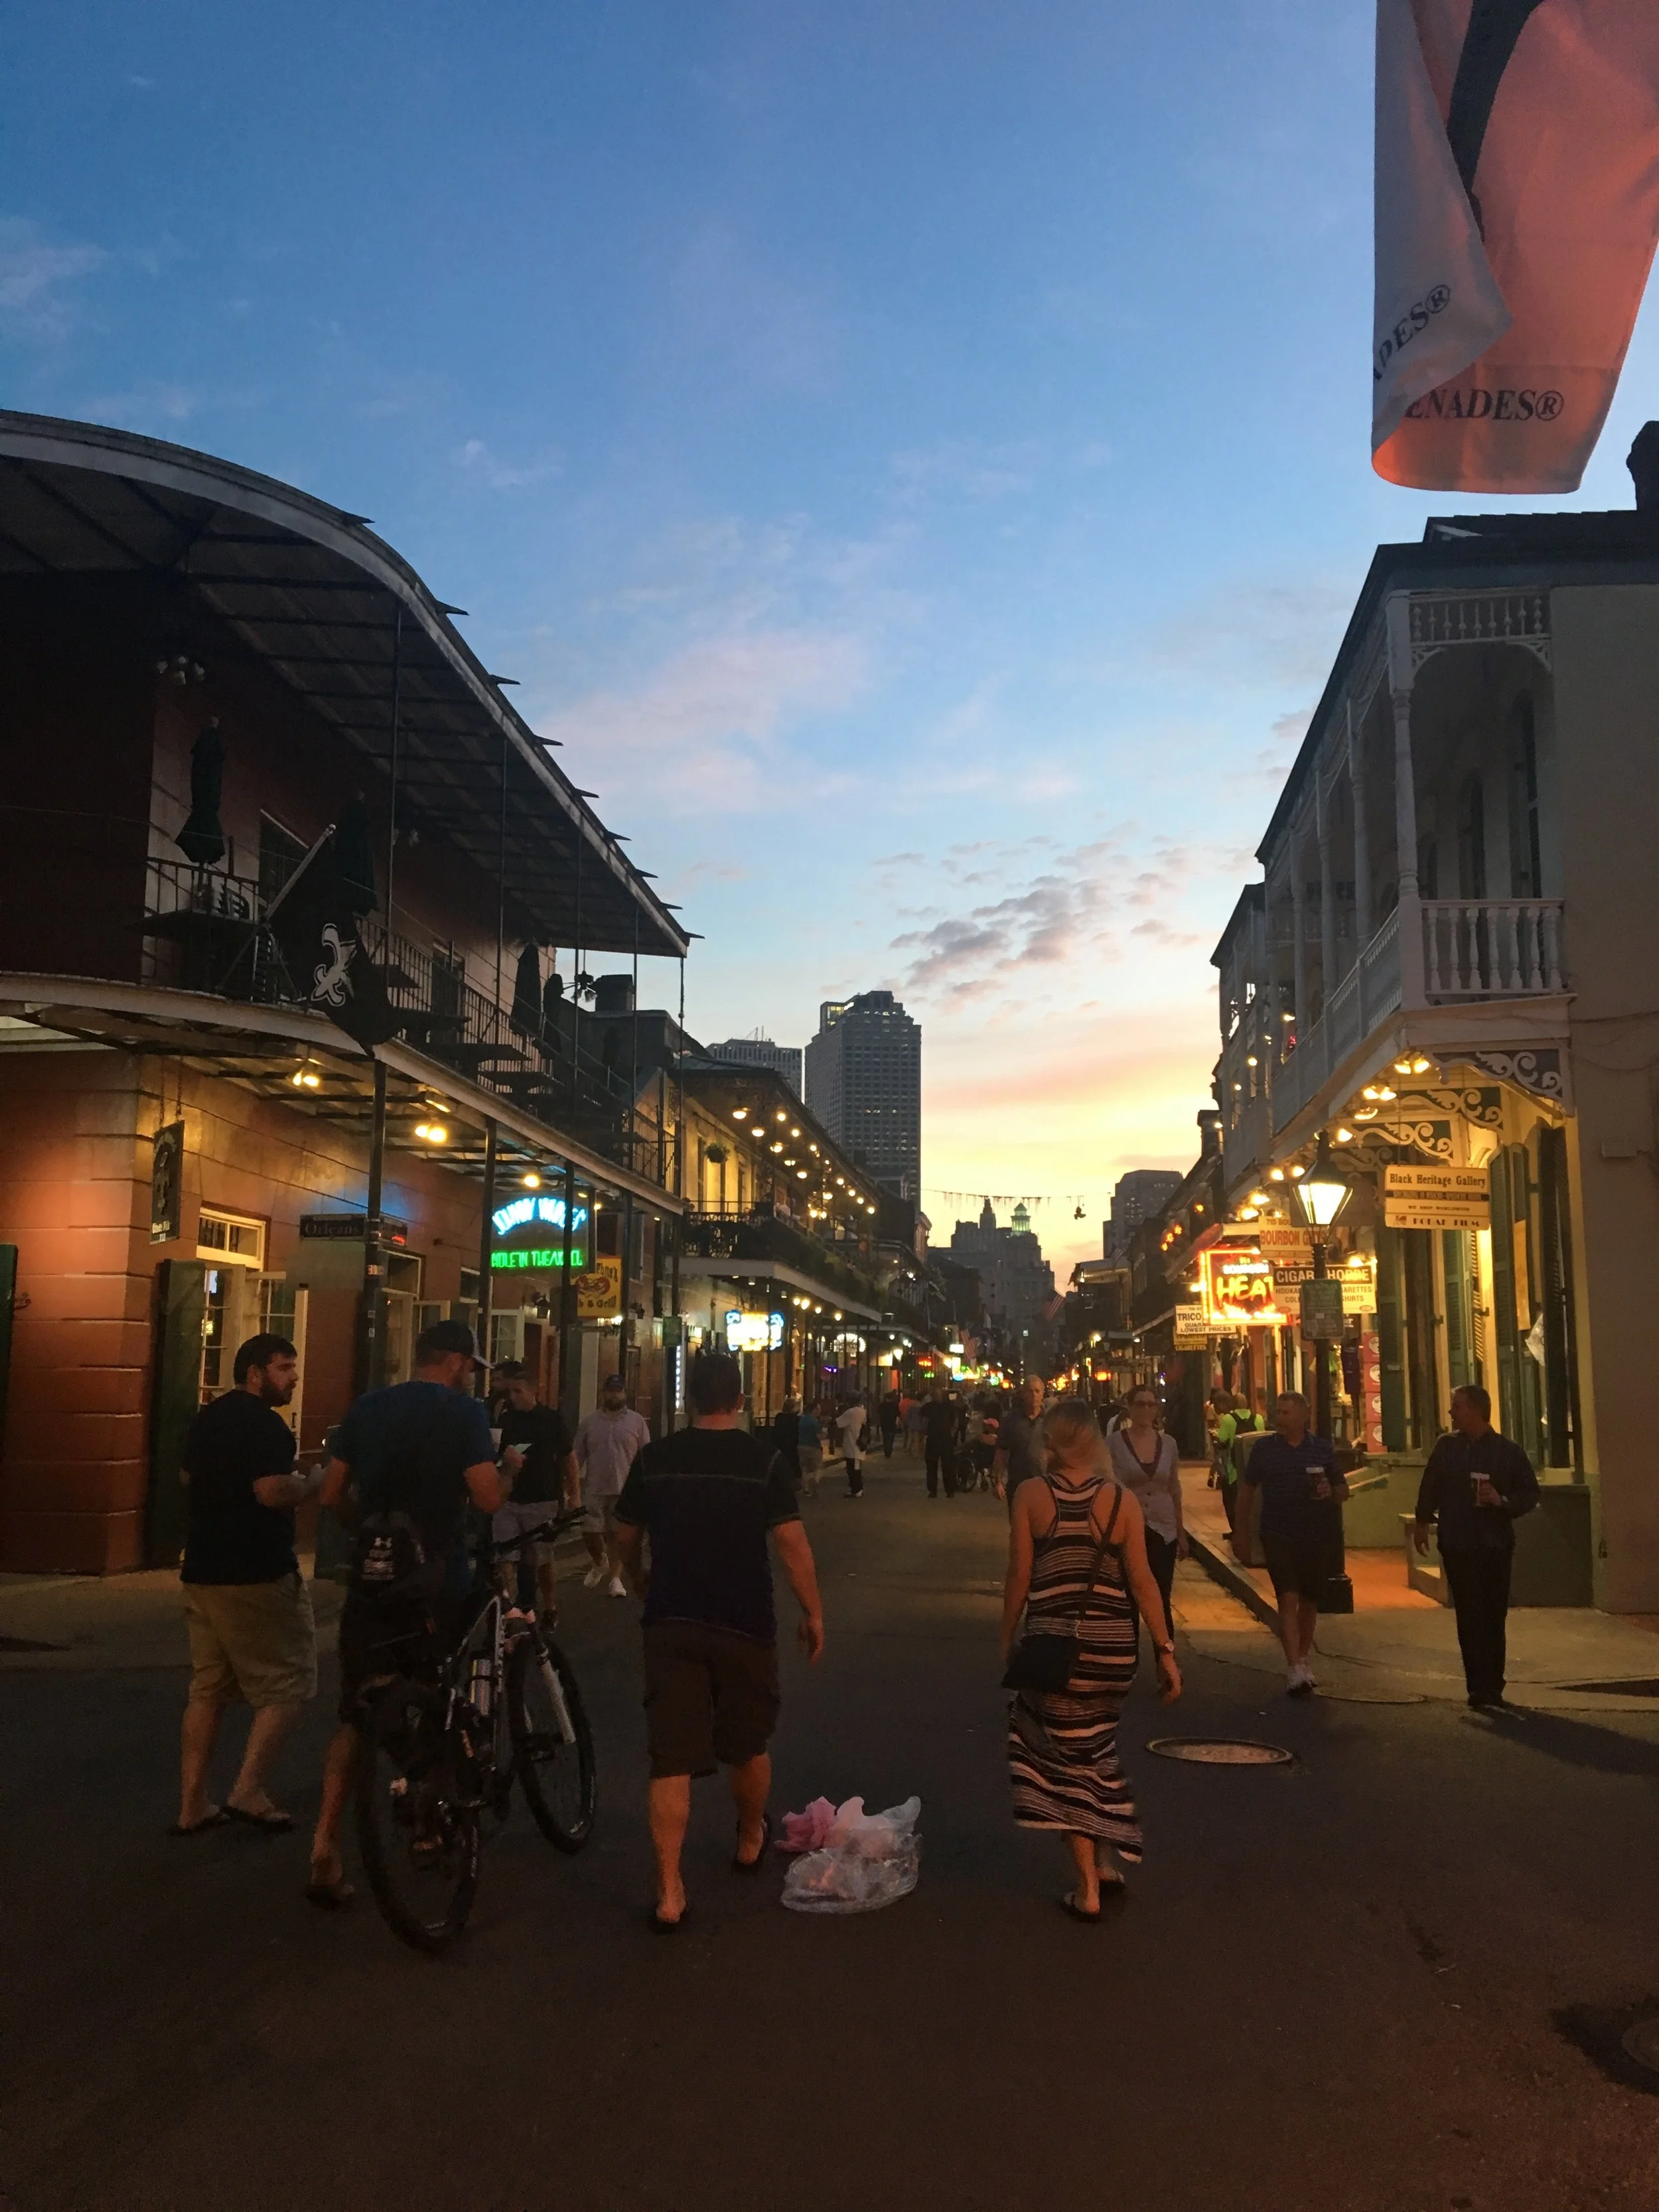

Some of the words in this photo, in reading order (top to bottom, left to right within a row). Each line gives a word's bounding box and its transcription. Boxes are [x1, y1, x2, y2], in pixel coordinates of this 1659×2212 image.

[1390, 1173, 1412, 1183] Black
[1417, 1174, 1451, 1187] Heritage
[1456, 1175, 1486, 1189] Gallery
[305, 1222, 360, 1236] Orleans
[1260, 1230, 1300, 1245] BOURBON
[1276, 1269, 1315, 1283] CIGAR
[1327, 1269, 1370, 1282] HOPPE
[1216, 1276, 1273, 1307] HEAT
[597, 1295, 617, 1309] Grill
